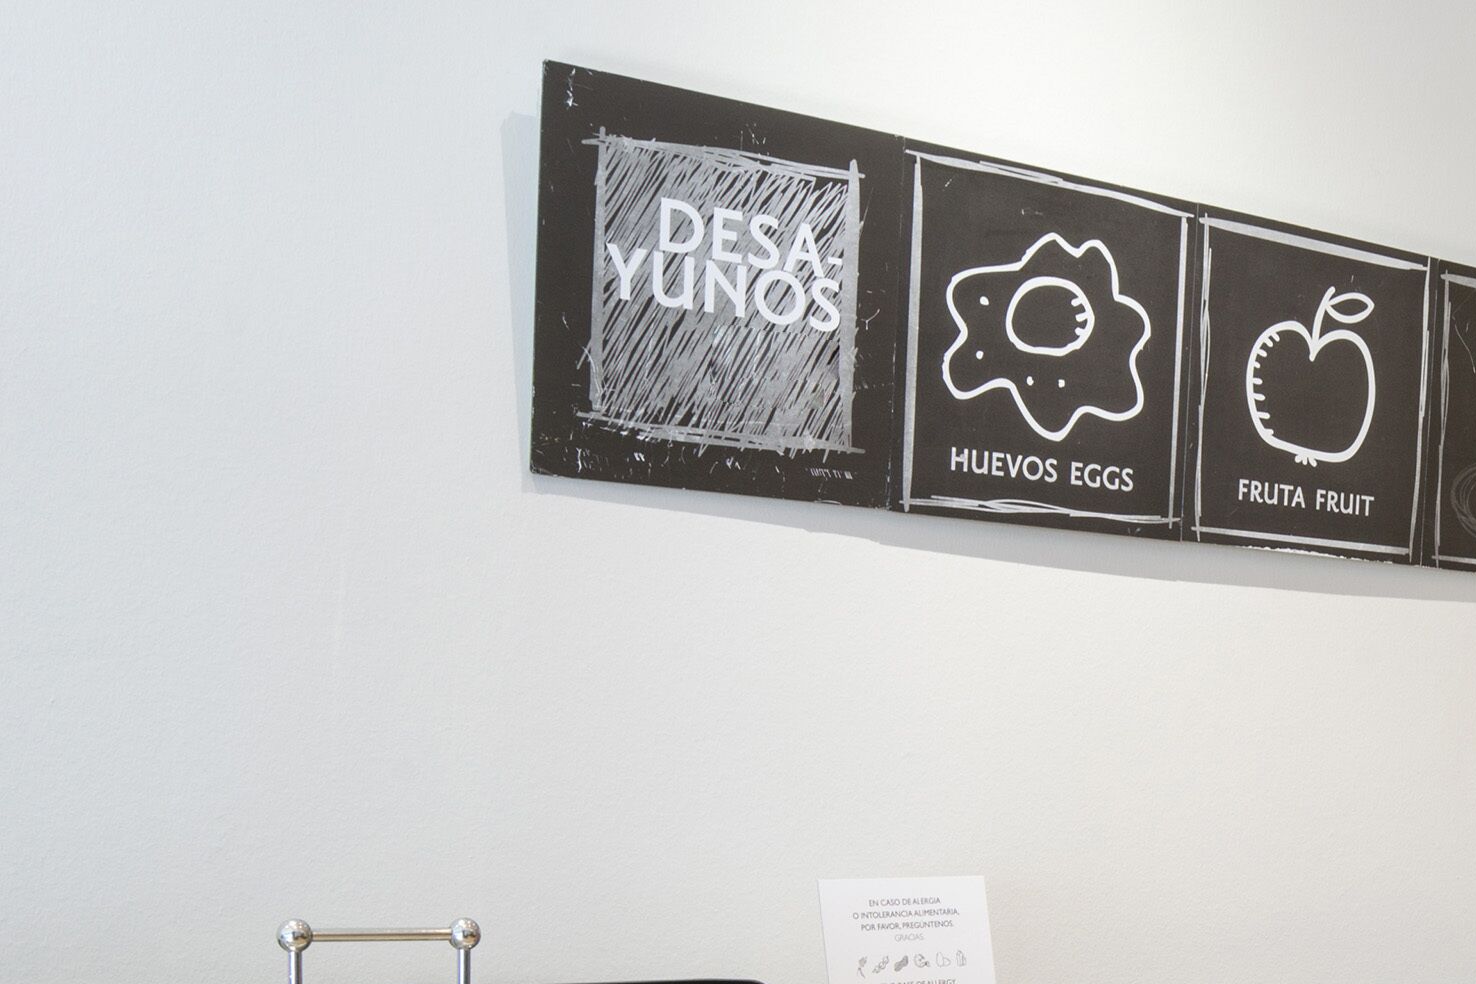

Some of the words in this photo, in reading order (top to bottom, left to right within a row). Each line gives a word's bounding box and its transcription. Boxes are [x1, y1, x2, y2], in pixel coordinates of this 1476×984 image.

[659, 197, 843, 278] DESA-
[606, 243, 841, 332] YUNOS
[950, 446, 1058, 483] HUEVOS
[1070, 461, 1134, 492] EGGS
[1238, 478, 1306, 509] FRUTA
[1315, 488, 1375, 517] FRUIT
[852, 912, 860, 920] O
[861, 910, 912, 919] INTOLERANCIA
[868, 899, 879, 907] EN
[880, 898, 900, 906] CASO
[901, 898, 911, 906] DE
[861, 923, 876, 931] POR
